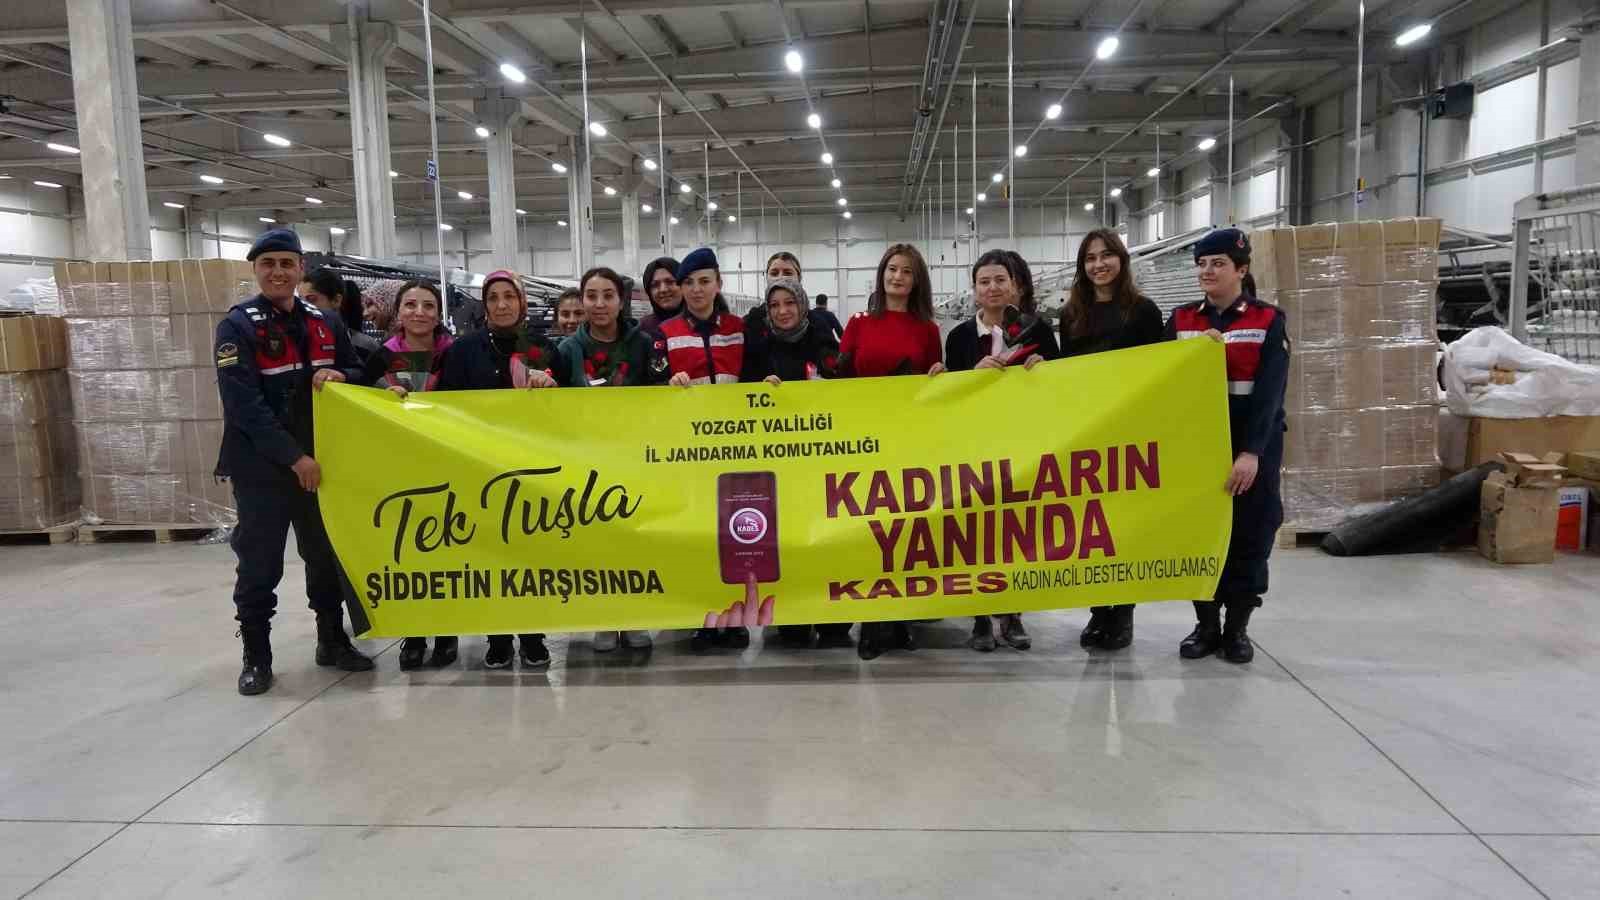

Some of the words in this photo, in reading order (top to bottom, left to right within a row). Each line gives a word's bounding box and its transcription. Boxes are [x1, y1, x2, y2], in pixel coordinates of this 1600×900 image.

[746, 394, 775, 408] T.C.
[691, 419, 757, 435] YOZGAT
[762, 413, 833, 433] VALİLİĞİ
[646, 445, 660, 463] İL
[666, 446, 758, 462] JANDARMA
[763, 437, 880, 458] KOMUTANLIĞI
[825, 441, 1161, 518] KADINLARIN
[373, 482, 476, 565] Tek
[480, 465, 643, 544] Tuşla
[869, 499, 1116, 573] YANINDA
[366, 563, 491, 608] ŞİDDETİN
[501, 568, 665, 604] KARŞISINDA
[828, 571, 1009, 601] KADES
[1013, 571, 1051, 591] KADIN
[1054, 564, 1081, 587] ACİL
[1084, 562, 1134, 585] DESTEK
[1137, 556, 1220, 581] UYGULAMASI
